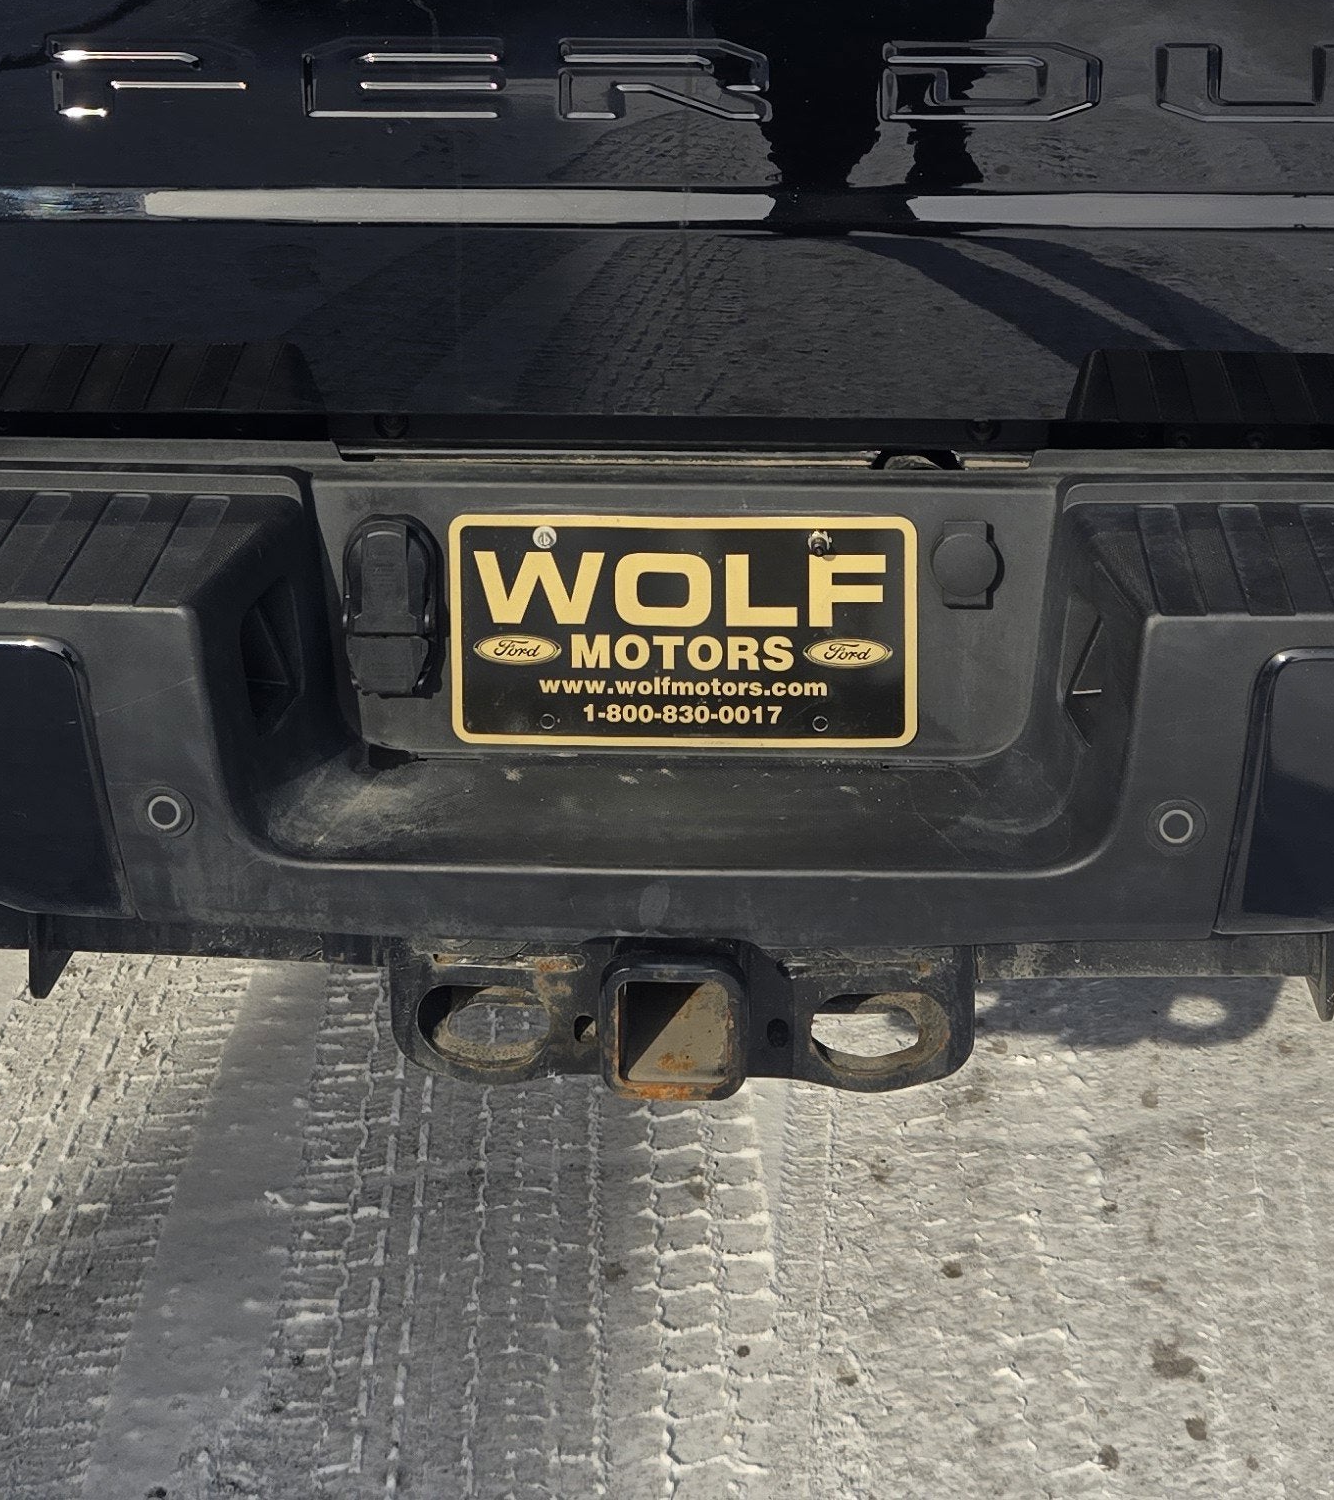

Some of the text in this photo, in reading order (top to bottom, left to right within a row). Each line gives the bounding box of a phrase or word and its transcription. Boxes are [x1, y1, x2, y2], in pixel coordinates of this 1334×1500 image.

[473, 550, 887, 627] WOLF
[493, 639, 541, 657] Ford
[571, 633, 795, 672] MOTORS
[823, 642, 872, 660] Ford
[539, 676, 828, 698] www.wolfmotors.com
[583, 703, 783, 725] 1-800-830-0017
